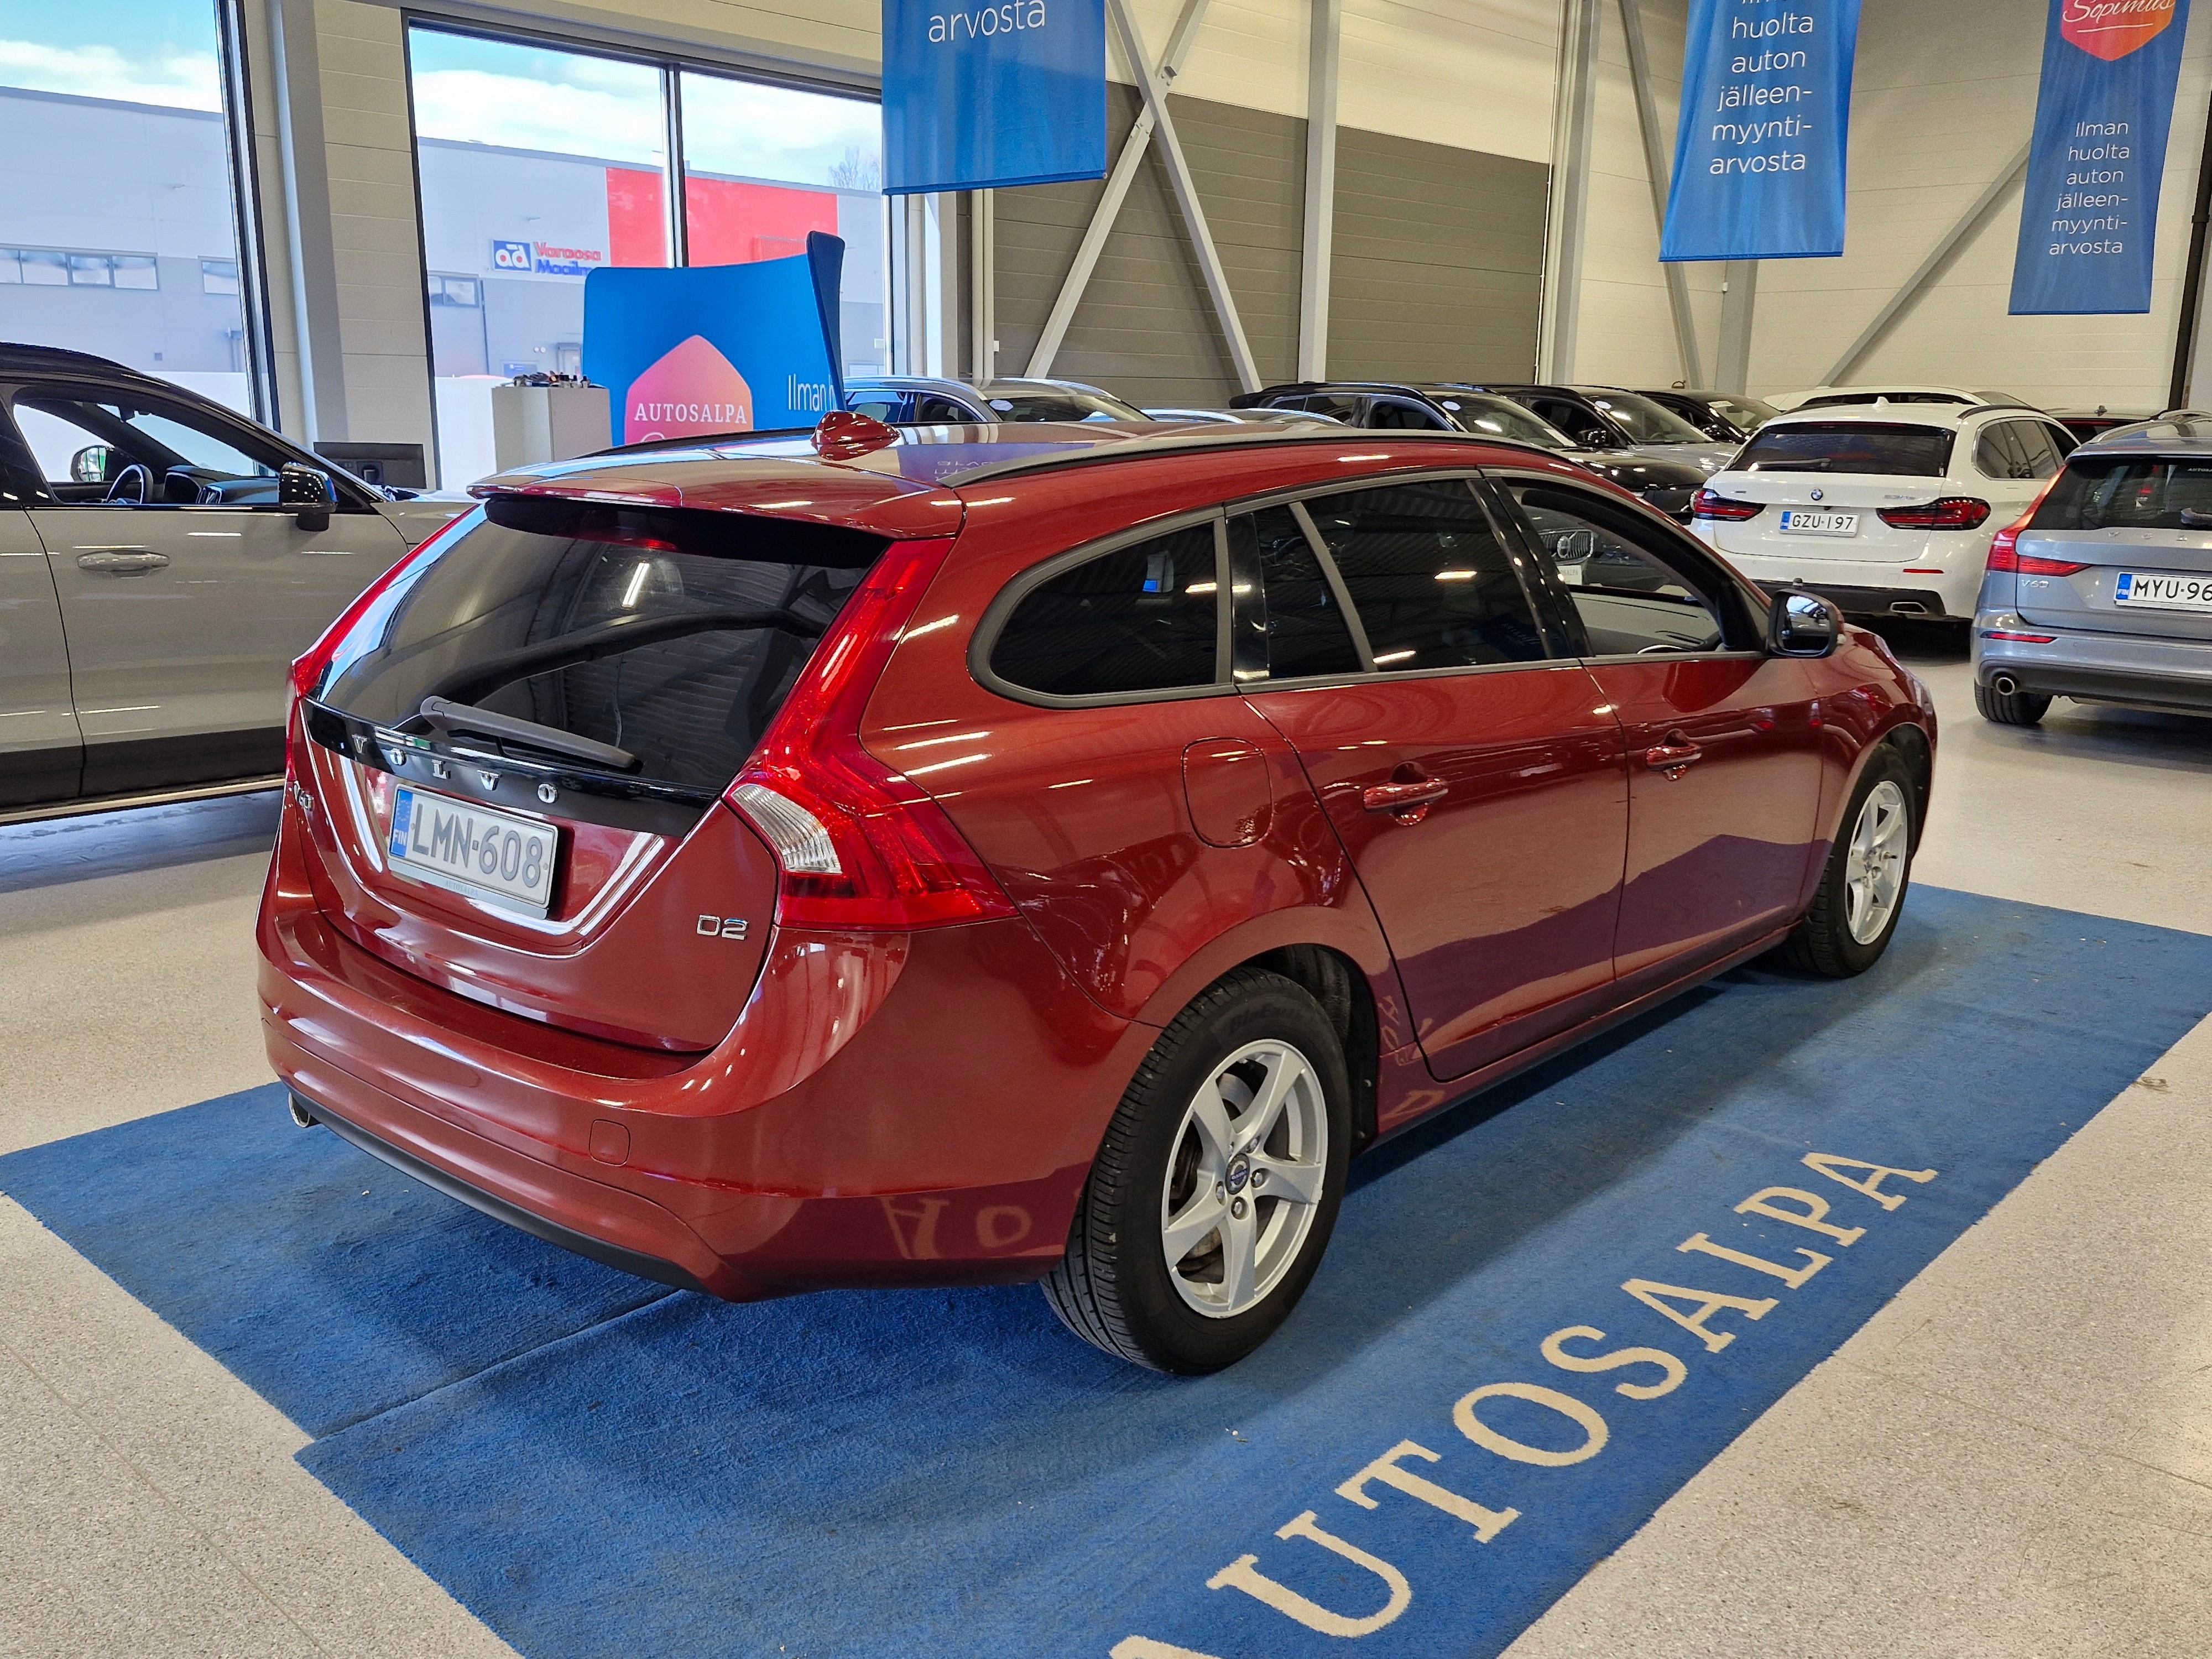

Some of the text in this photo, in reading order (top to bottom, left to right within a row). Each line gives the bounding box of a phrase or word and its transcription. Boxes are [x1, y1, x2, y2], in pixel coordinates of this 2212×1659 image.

[928, 0, 1045, 43] arvosta
[1732, 12, 1813, 39] huolta
[1731, 50, 1806, 73] auton
[1717, 84, 1812, 112] jälleen-
[1712, 114, 1812, 144] myynti-
[2075, 121, 2128, 137] Ilman
[1709, 150, 1806, 174] arvosta
[2068, 143, 2130, 161] huolta
[2067, 169, 2124, 185] auton
[2055, 192, 2128, 212] jälleen-
[2052, 215, 2127, 234] myynti-
[2049, 239, 2122, 255] arvosta
[789, 373, 827, 412] Ilman
[634, 403, 747, 424] AUTOSALPA
[1792, 514, 1854, 530] GZU-197
[352, 734, 559, 804] VOLVO
[393, 803, 542, 888] FIN LMN-608
[697, 914, 749, 940] D2
